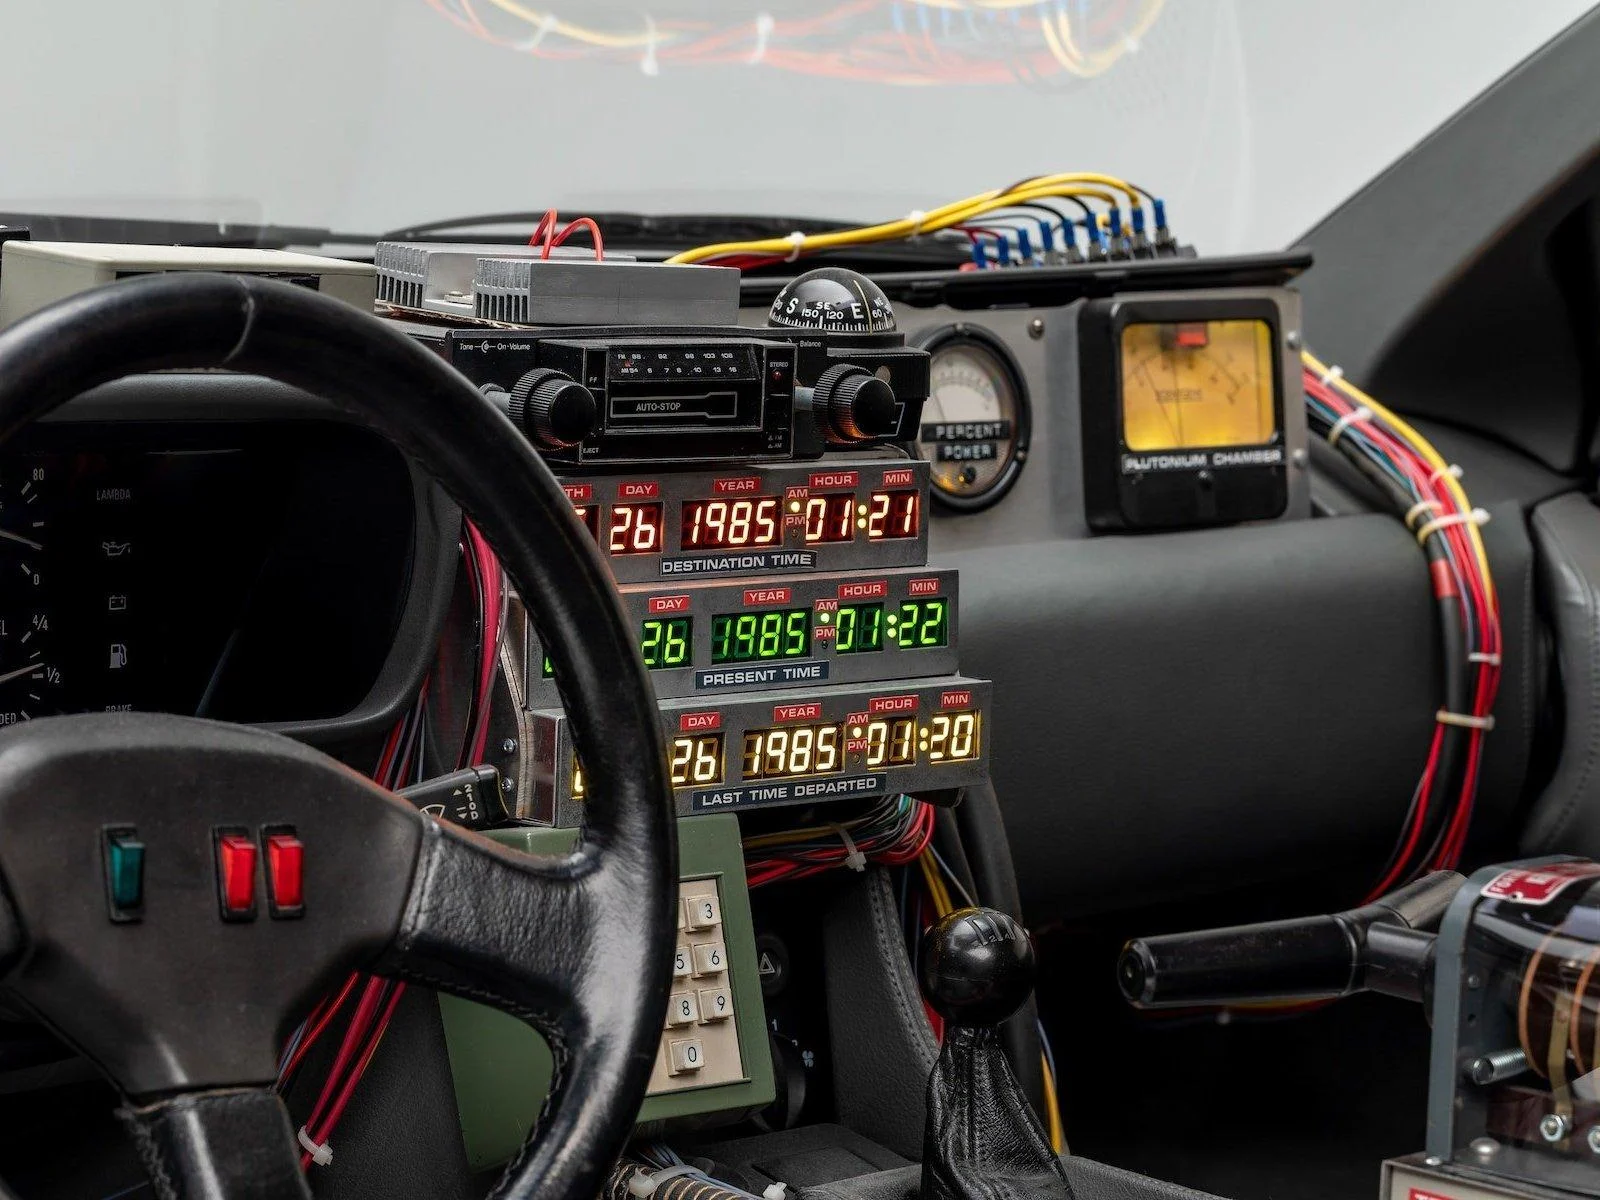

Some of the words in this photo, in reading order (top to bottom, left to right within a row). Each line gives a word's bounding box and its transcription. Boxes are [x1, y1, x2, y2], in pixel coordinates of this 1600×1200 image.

[786, 297, 799, 314] S
[815, 301, 831, 310] SE
[850, 302, 864, 319] E
[801, 308, 819, 318] 150
[826, 311, 844, 319] 120
[872, 308, 883, 318] 60
[800, 340, 822, 348] Balance
[636, 402, 681, 412] AUTO-STOP
[935, 423, 1002, 439] PERCENT
[944, 444, 991, 460] POWER
[1125, 454, 1206, 471] PLUTONIUM
[1212, 449, 1282, 466] CHAMBER
[33, 468, 45, 481] 80
[814, 474, 853, 486] HOUR
[885, 472, 910, 484] MIN
[626, 485, 652, 495] DAY
[719, 480, 755, 491] YEAR
[96, 489, 132, 500] LAMBDA
[788, 488, 808, 498] AM
[609, 507, 656, 551] 26
[690, 499, 776, 544] 1985
[786, 515, 806, 526] PM
[662, 554, 766, 573] DESTINATION
[771, 553, 812, 567] TIME
[33, 574, 40, 586] 0
[844, 584, 882, 596] HOUR
[911, 581, 936, 593] MIN
[749, 590, 786, 602] YEAR
[656, 598, 683, 610] DAY
[817, 601, 838, 611] AM
[816, 627, 836, 638] PM
[641, 622, 685, 665] 26
[721, 613, 806, 657] 1985
[703, 670, 777, 686] PRESENT
[783, 667, 821, 679] TIME
[874, 698, 913, 711] HOUR
[943, 693, 968, 705] MIN
[779, 706, 816, 718] YEAR
[687, 715, 715, 727] DAY
[848, 714, 869, 725] AM
[847, 740, 867, 751] PM
[671, 740, 716, 783] 26
[753, 727, 836, 774] 1985
[464, 784, 473, 793] 2
[702, 791, 740, 806] LAST
[749, 787, 787, 800] TIME
[794, 777, 877, 797] DEPARTED
[467, 794, 473, 802] 1
[705, 903, 713, 919] 3
[676, 953, 685, 969] 5
[711, 951, 720, 965] 6
[682, 1000, 690, 1016] 8
[717, 996, 726, 1011] 9
[687, 1046, 697, 1063] 0
